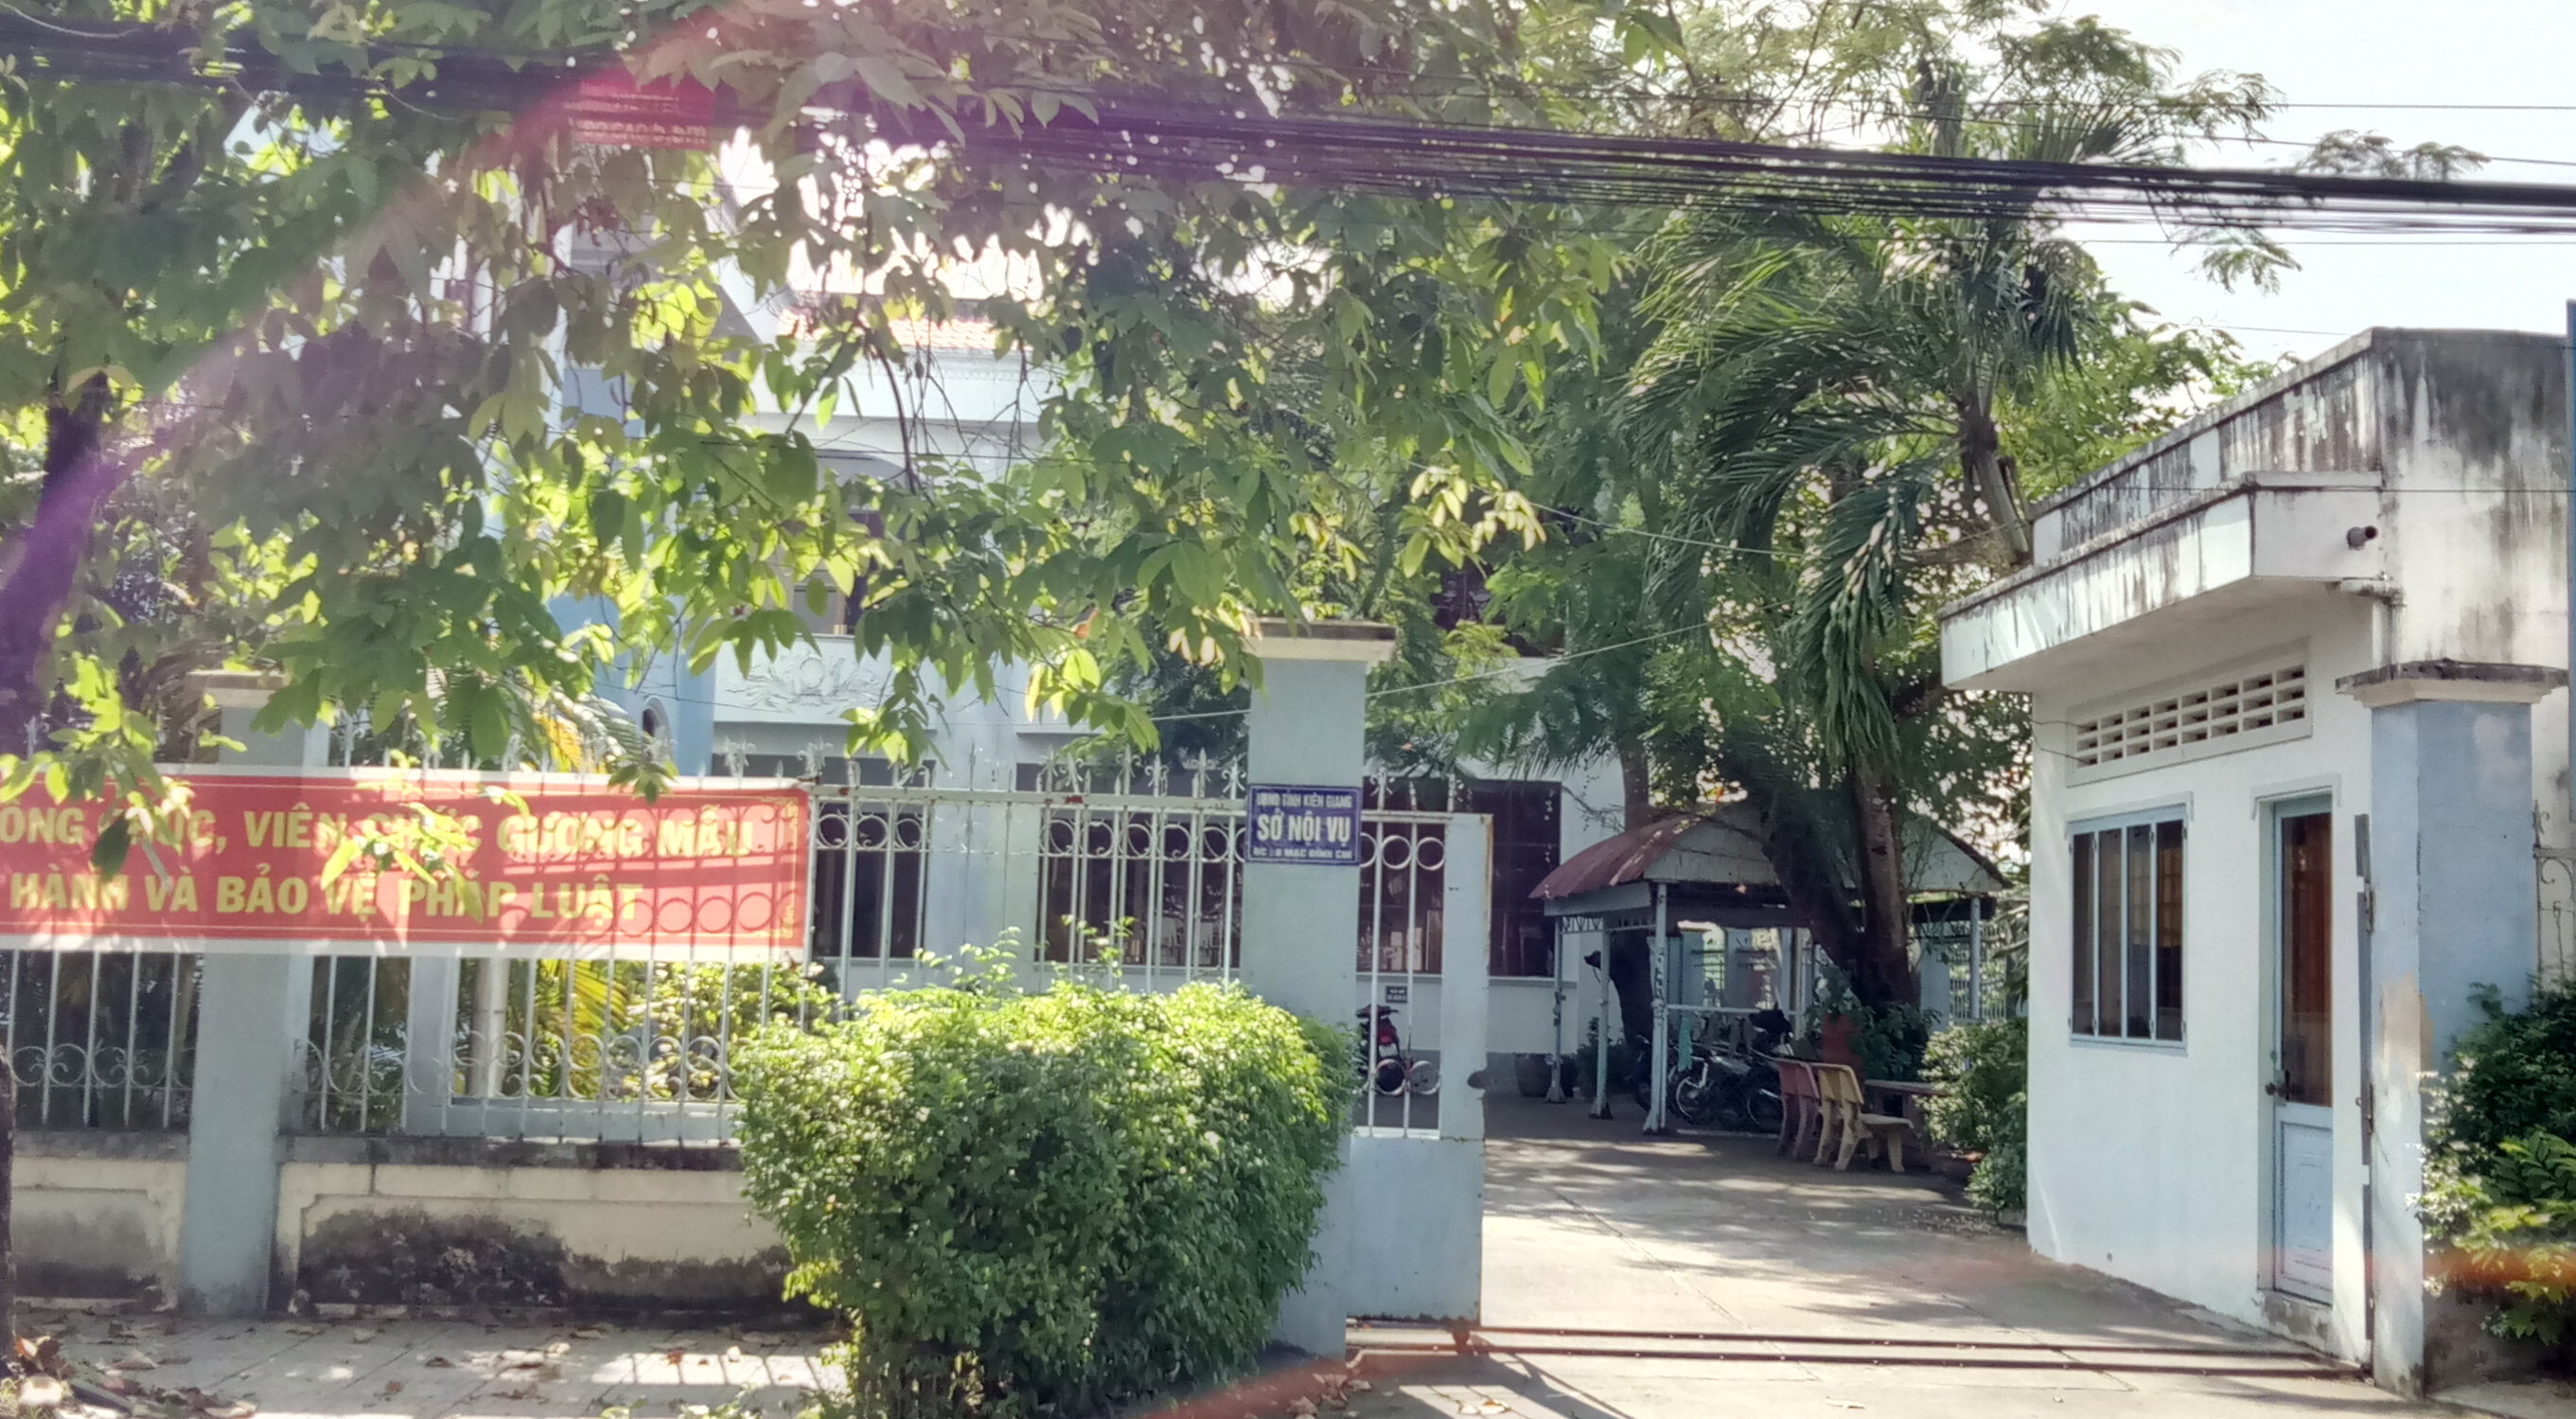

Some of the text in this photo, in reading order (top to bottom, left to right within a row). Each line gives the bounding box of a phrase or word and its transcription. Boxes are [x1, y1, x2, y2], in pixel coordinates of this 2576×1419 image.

[245, 802, 347, 849] VIÊN
[497, 811, 644, 858] GƯƠNG
[1257, 807, 1350, 847] SỞ NỘI VỤ
[10, 863, 129, 911] HÀNH
[146, 867, 198, 913] VÀ
[216, 863, 309, 914] BẢO
[531, 874, 644, 926] LUẬT
